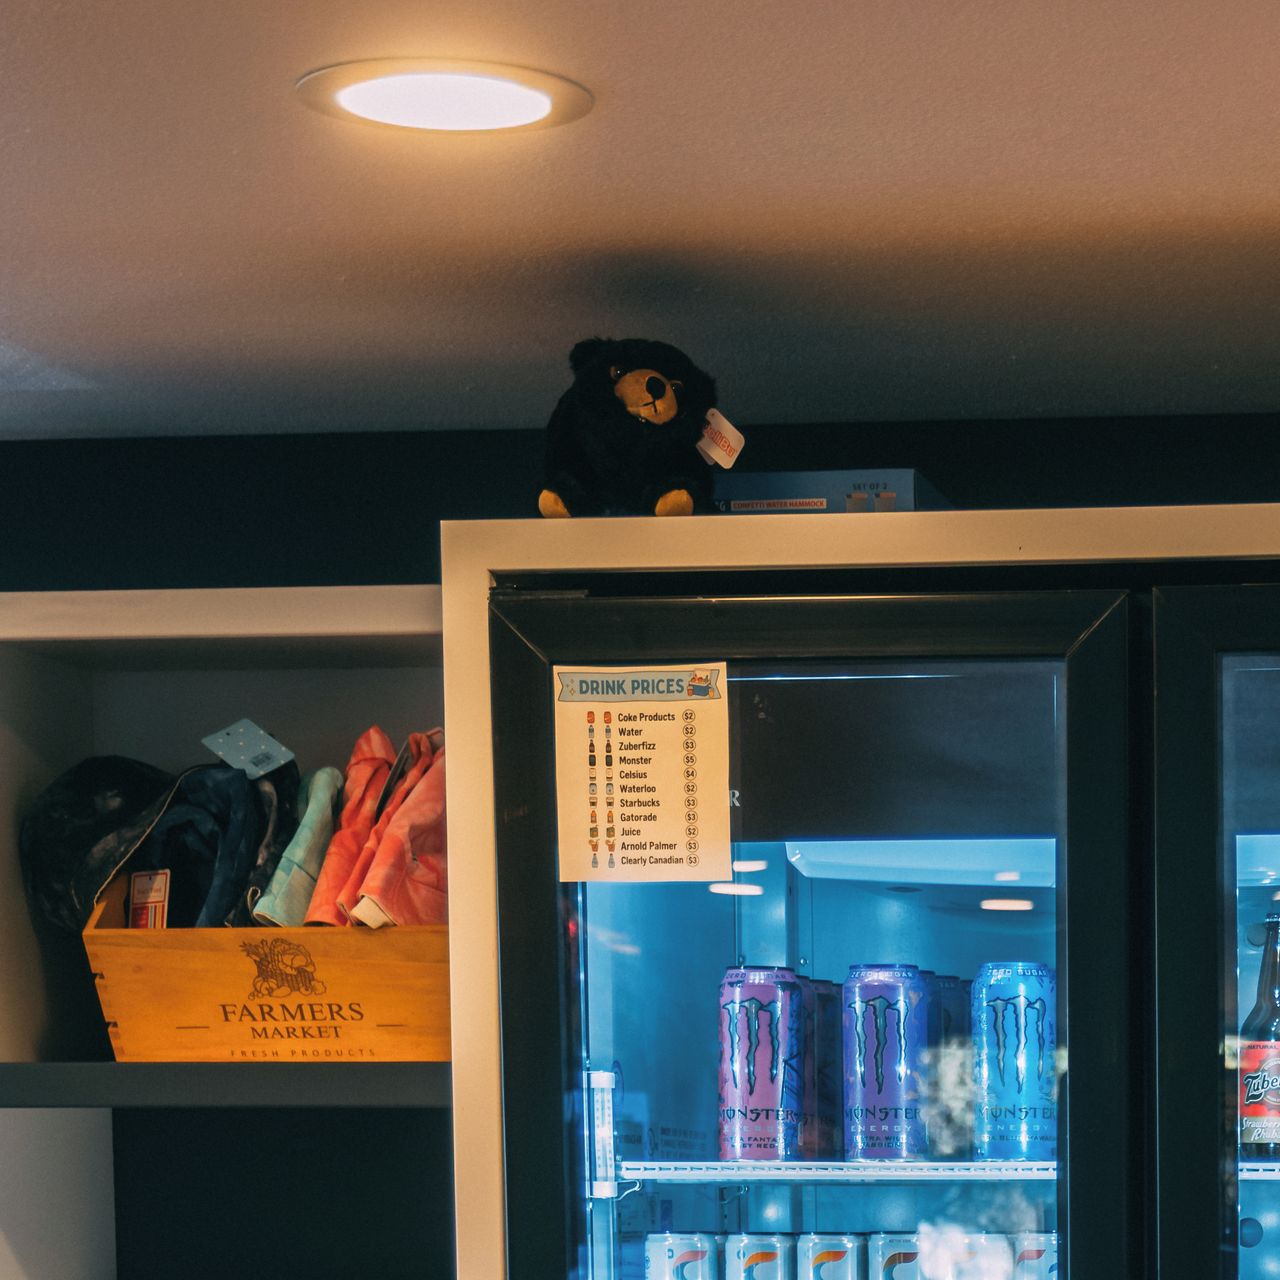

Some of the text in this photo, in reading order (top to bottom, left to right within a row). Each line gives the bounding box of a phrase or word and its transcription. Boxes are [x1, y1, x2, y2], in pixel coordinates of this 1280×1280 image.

[579, 679, 684, 695] DRINK PRICES
[618, 712, 693, 722] Coke Products $2
[619, 727, 693, 736] Water $2
[619, 741, 694, 751] Zuberfizz $3
[619, 755, 694, 765] Monster $5
[619, 770, 695, 779] Celsius $4
[620, 784, 695, 793] Waterloo $2
[620, 799, 695, 808] Starbucks $3
[621, 813, 696, 822] Gatorade $3
[621, 828, 696, 836] Juice $2
[621, 842, 696, 850] Arnold Palmer $3
[621, 856, 697, 866] Clearly Canadian $3
[220, 1002, 365, 1023] FARMERS
[250, 1025, 342, 1039] MARKET
[230, 1047, 376, 1058] FRESH PRODUCTS
